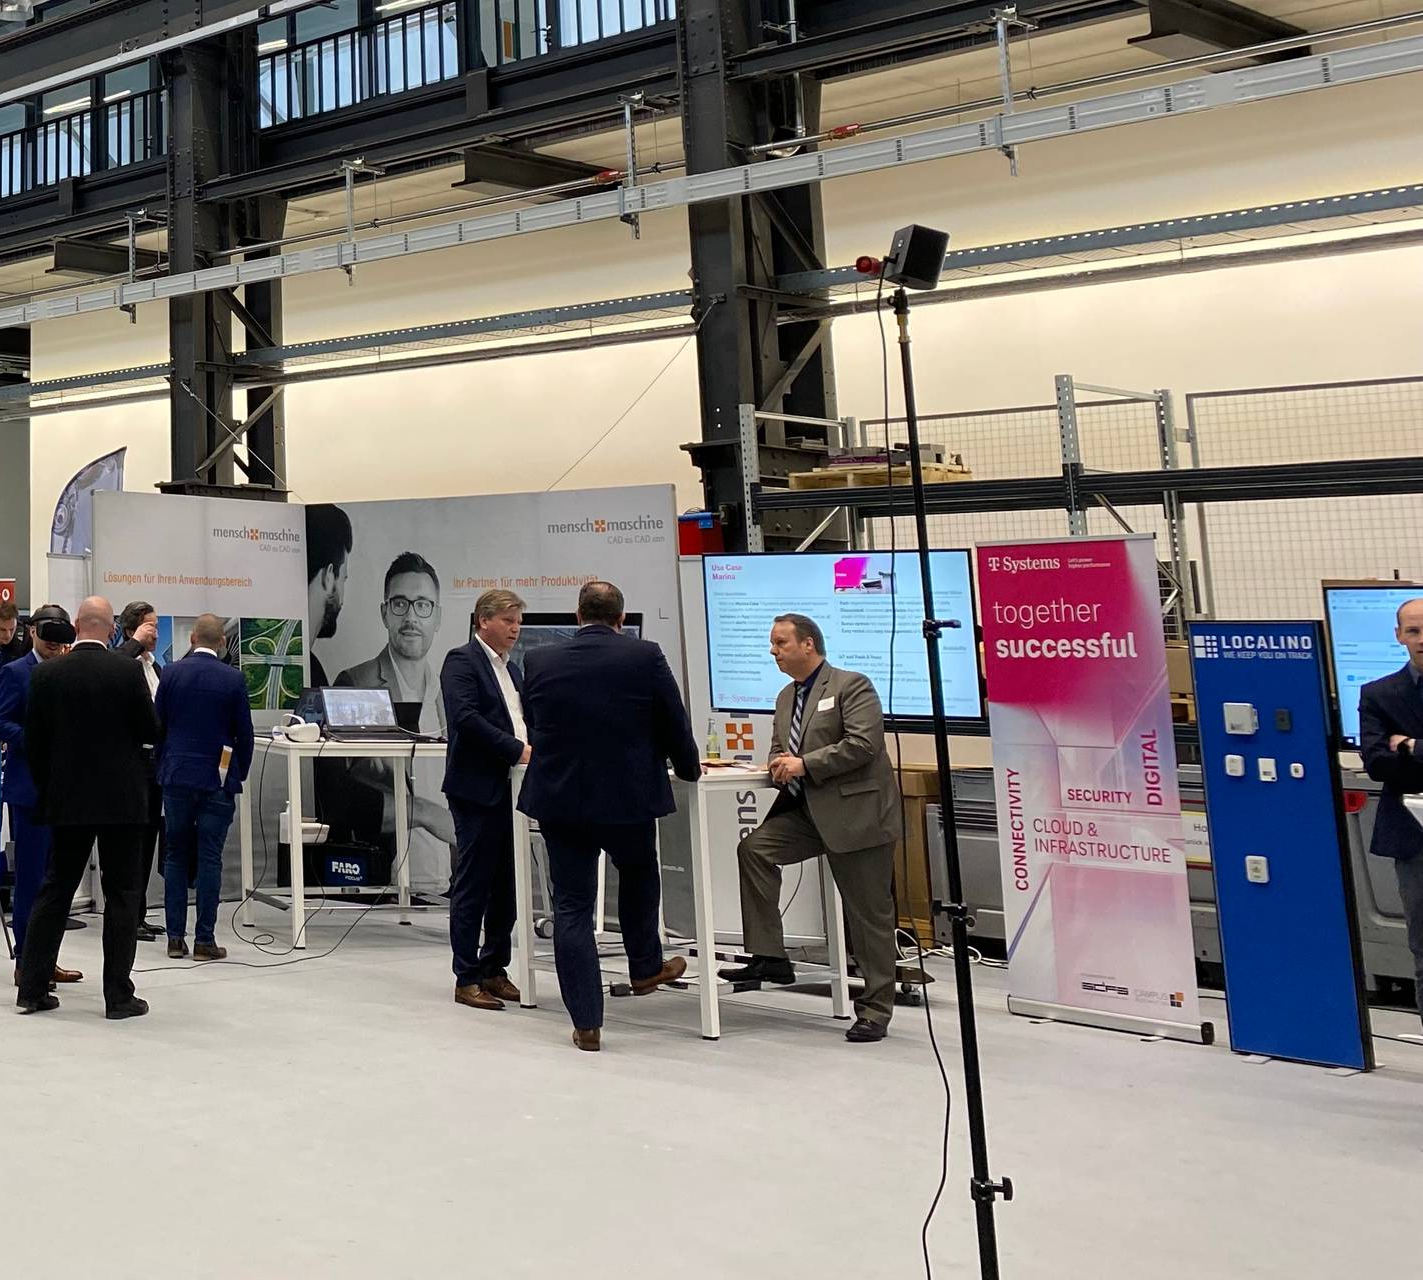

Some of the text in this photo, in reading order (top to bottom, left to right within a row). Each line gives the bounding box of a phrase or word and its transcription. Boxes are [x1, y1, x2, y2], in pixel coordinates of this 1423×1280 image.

[547, 515, 664, 534] mensch maschine
[213, 526, 300, 542] mensch maschine
[725, 563, 742, 571] Case
[1003, 556, 1061, 574] Systems
[103, 571, 253, 588] Lösungen für Ihren Anwendungsbereich
[453, 576, 465, 588] Ihr
[467, 576, 498, 588] Partner
[501, 576, 512, 588] für
[515, 576, 538, 588] mehr
[993, 597, 1102, 630] together
[995, 631, 1138, 659] successful
[1221, 635, 1313, 650] LOCALINO
[1237, 651, 1257, 659] KEEP
[1258, 651, 1274, 659] YOU
[1288, 652, 1314, 660] TRACK
[1140, 729, 1163, 806] DIGITAL
[1067, 788, 1133, 804] SECURITY
[1006, 768, 1030, 892] CONNECTIVITY
[1033, 818, 1099, 837] CLOUD &
[1034, 837, 1172, 864] INFRASTRUCTURE
[331, 861, 361, 875] FARO
